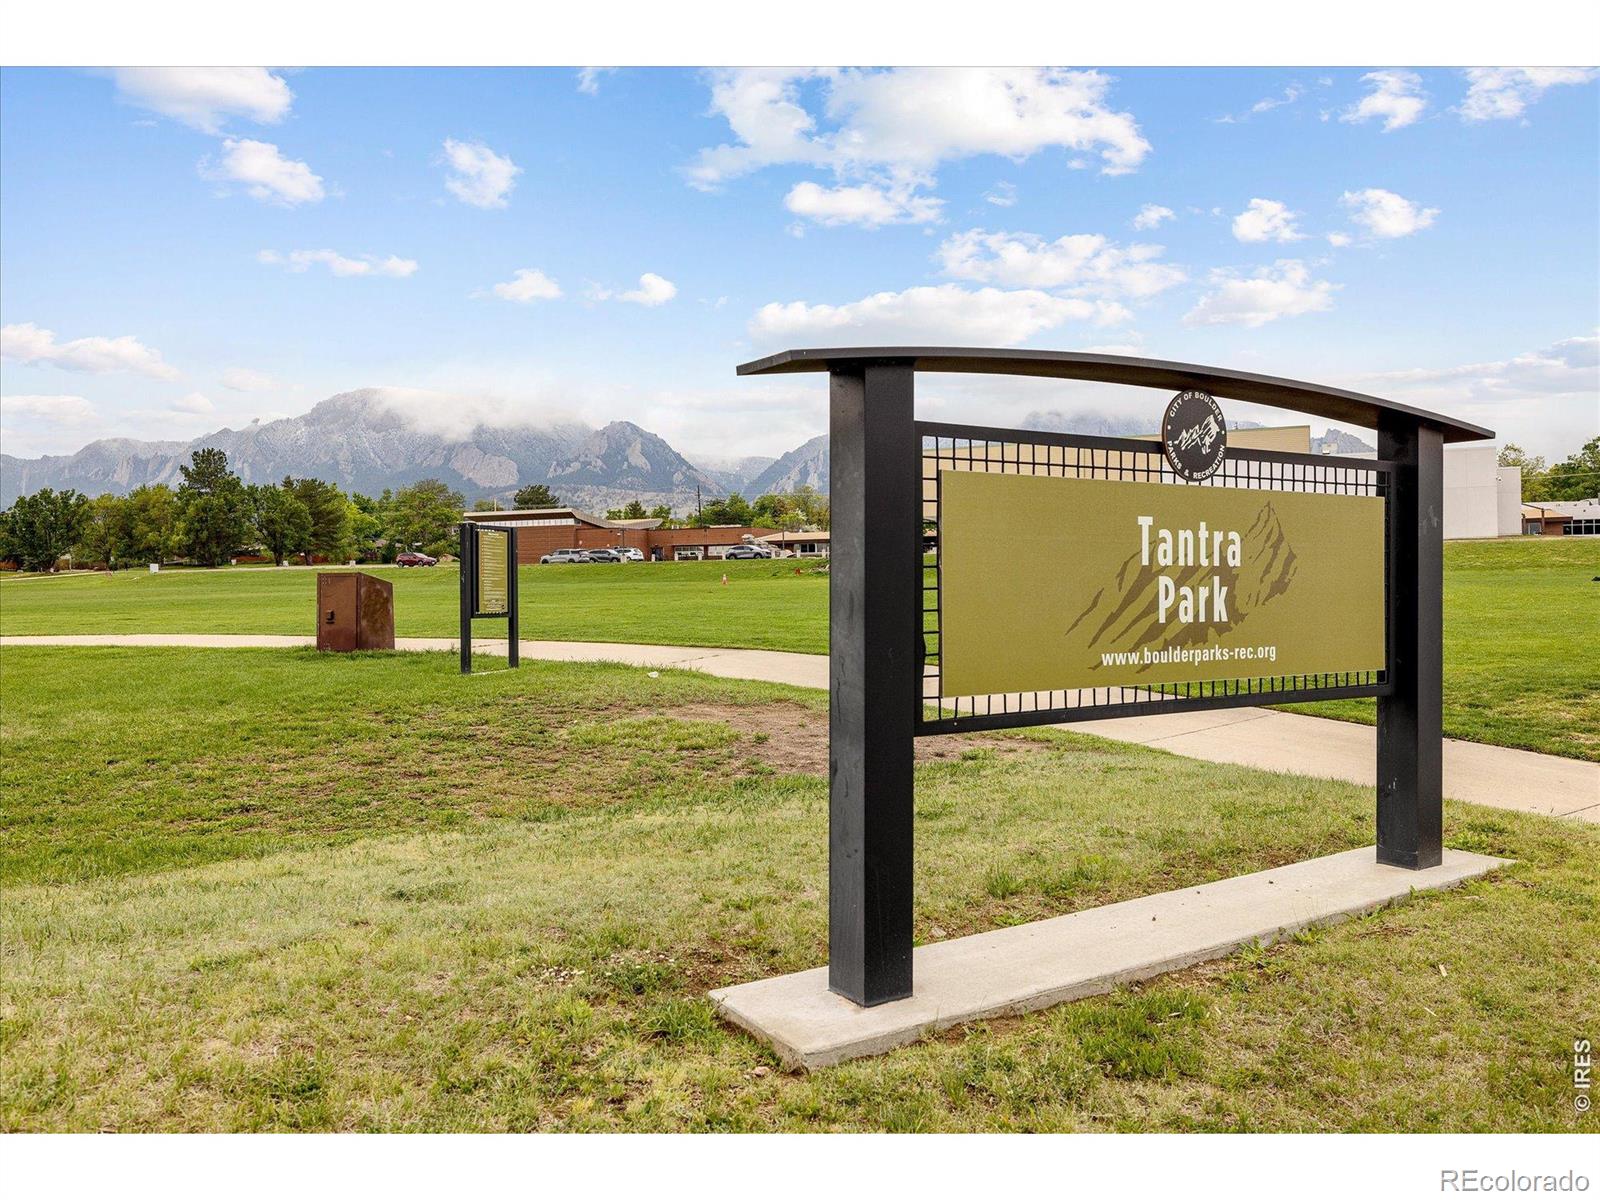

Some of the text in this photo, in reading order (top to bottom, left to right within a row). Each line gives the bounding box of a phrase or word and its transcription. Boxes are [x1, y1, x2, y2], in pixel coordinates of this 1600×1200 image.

[1169, 391, 1223, 422] CITY OF BOULDER
[1167, 440, 1226, 480] PARKS & RECREATION
[1137, 515, 1241, 567] Tantra
[1158, 575, 1229, 624] Park
[1101, 644, 1277, 666] www.boulderparks-rec.org
